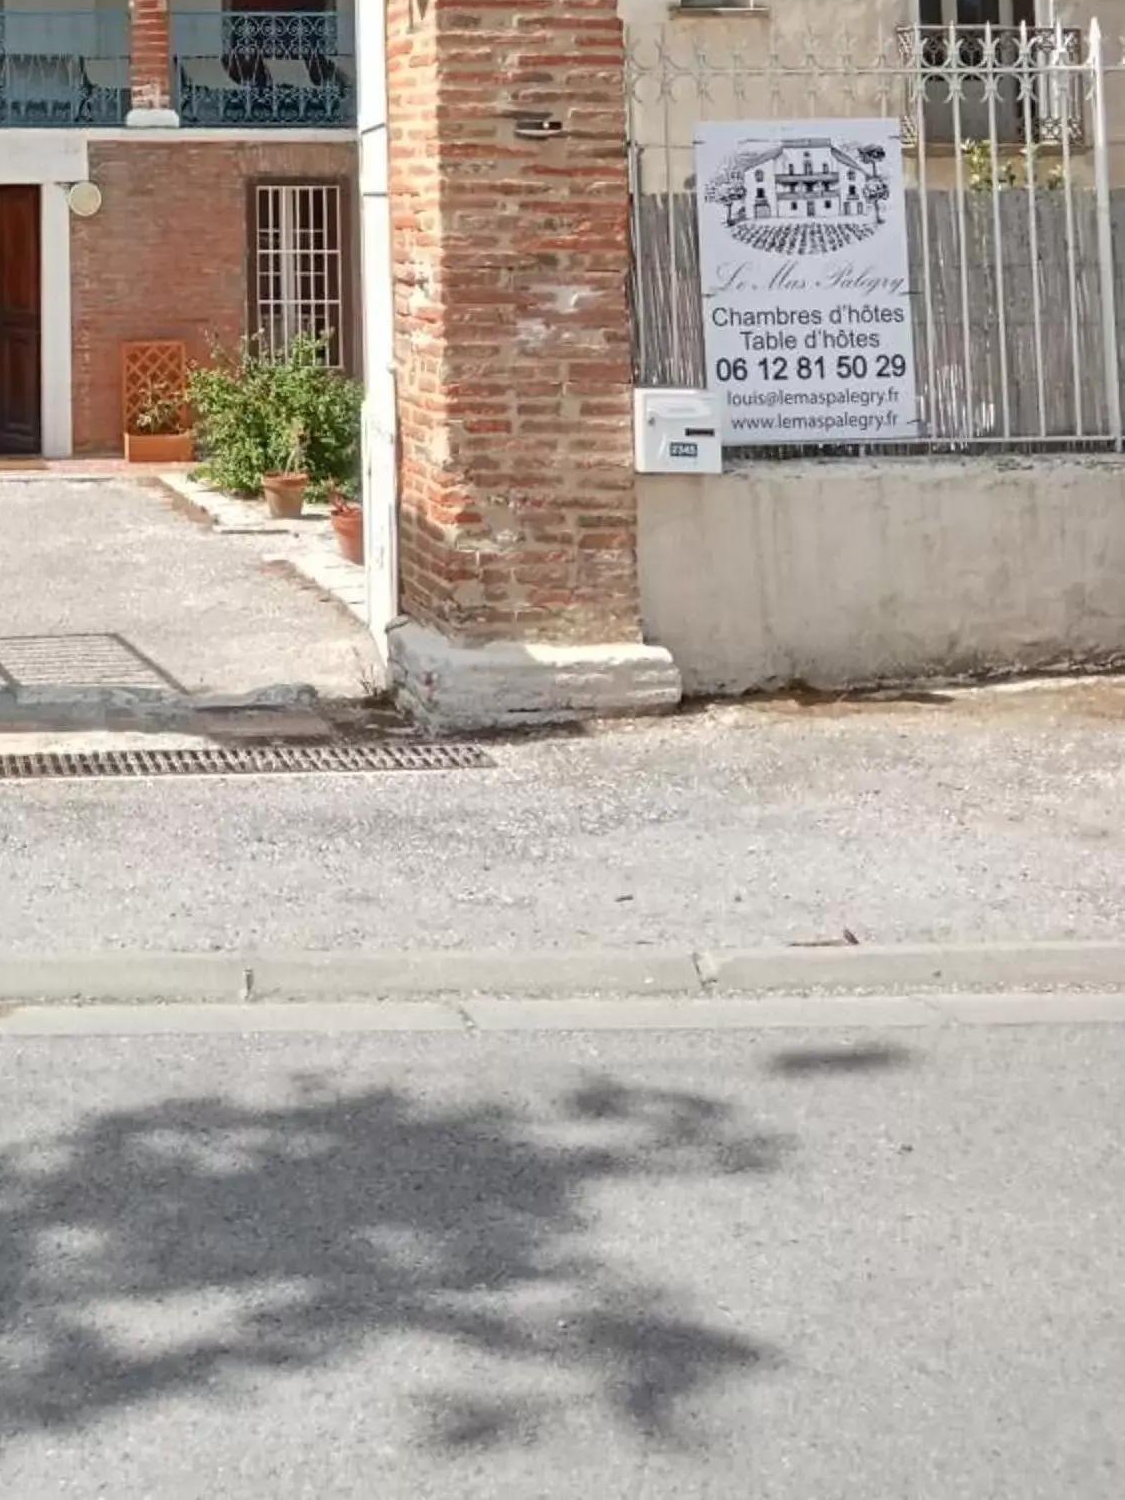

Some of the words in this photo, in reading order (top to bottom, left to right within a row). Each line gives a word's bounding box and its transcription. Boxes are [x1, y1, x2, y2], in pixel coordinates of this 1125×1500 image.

[712, 261, 746, 292] Le
[751, 260, 806, 291] Mas
[816, 261, 905, 295] Palegry
[712, 306, 822, 327] Chambres
[829, 304, 905, 324] d'hôtes
[739, 331, 797, 351] Table
[804, 329, 880, 349] d'hôtes
[716, 357, 748, 381] 06
[757, 356, 788, 380] 12
[796, 356, 825, 380] 81
[836, 355, 867, 379] 50
[875, 354, 906, 378] 29
[727, 386, 900, 407] louis@lemaspalegry.fr
[731, 411, 899, 431] www.lemaspalegry.fr
